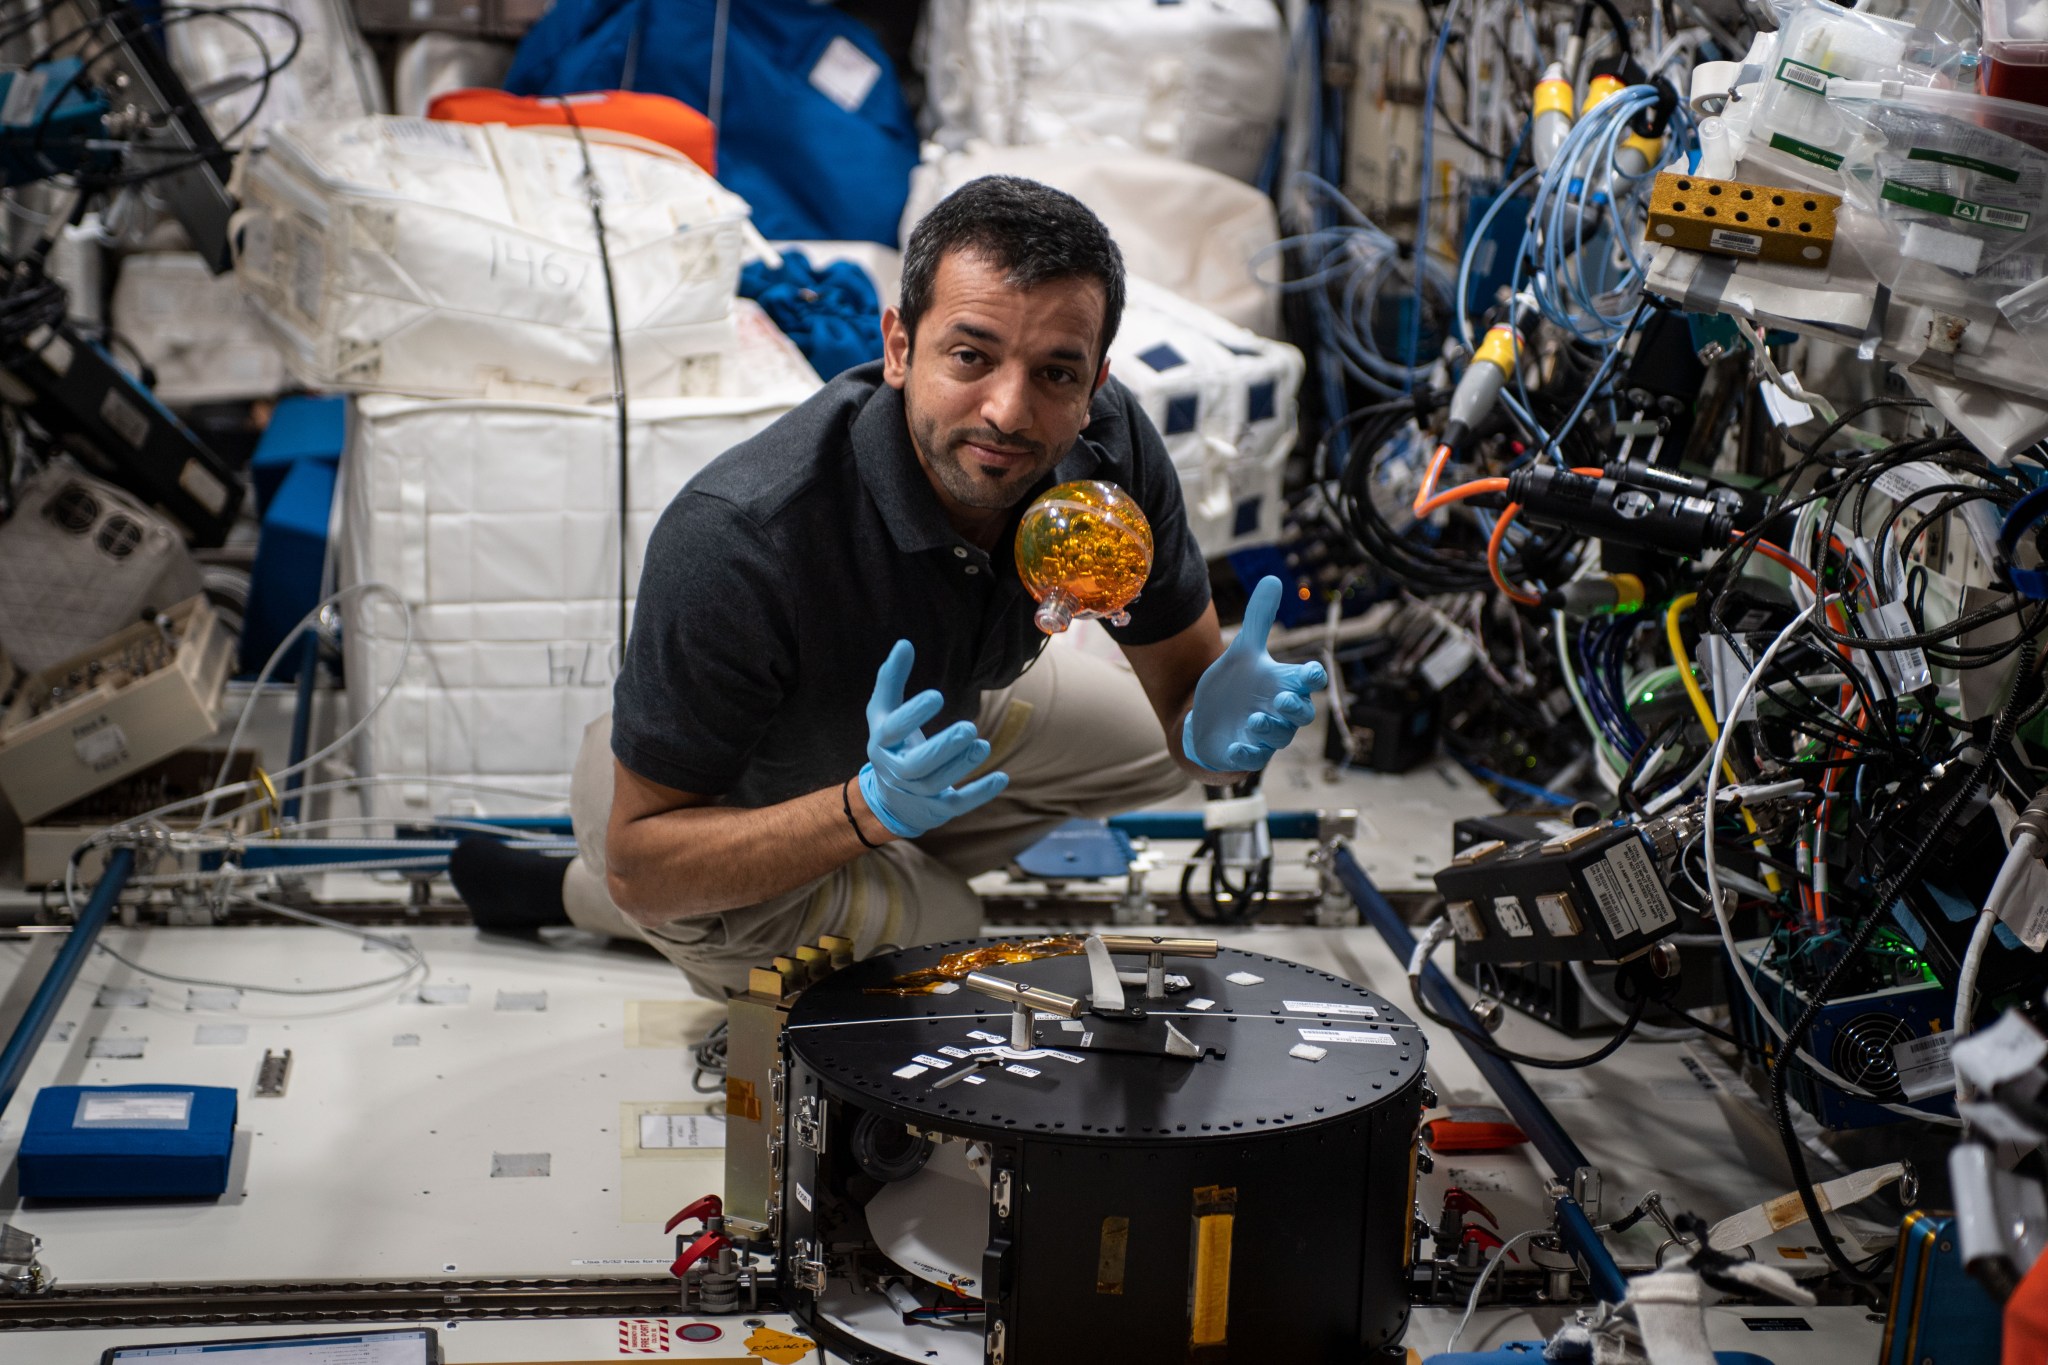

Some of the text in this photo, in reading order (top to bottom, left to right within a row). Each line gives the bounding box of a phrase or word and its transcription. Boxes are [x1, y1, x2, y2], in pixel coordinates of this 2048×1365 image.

[1797, 146, 1821, 159] Needles
[1887, 180, 1929, 197] Biocide Wipes
[1623, 850, 1631, 861] BUT
[1628, 860, 1636, 872] NOT
[1632, 871, 1639, 879] TO
[1636, 878, 1649, 899] EXCEED
[1648, 904, 1658, 919] AMPS
[1624, 842, 1666, 923] LIMITED TO INPUT SOURCE RATING
[1630, 843, 1669, 917] TOTAL STRIP OUTPUT CURRENT
[1620, 868, 1630, 883] AMPS
[1626, 882, 1635, 894] MAX
[1633, 896, 1647, 918] OUTLET)
[1053, 1052, 1080, 1062] UNLOCK
[1012, 1065, 1039, 1075] SYSTEM
[913, 1261, 949, 1275] ILLUMINATION
[640, 1324, 649, 1349] FIRE PORT
